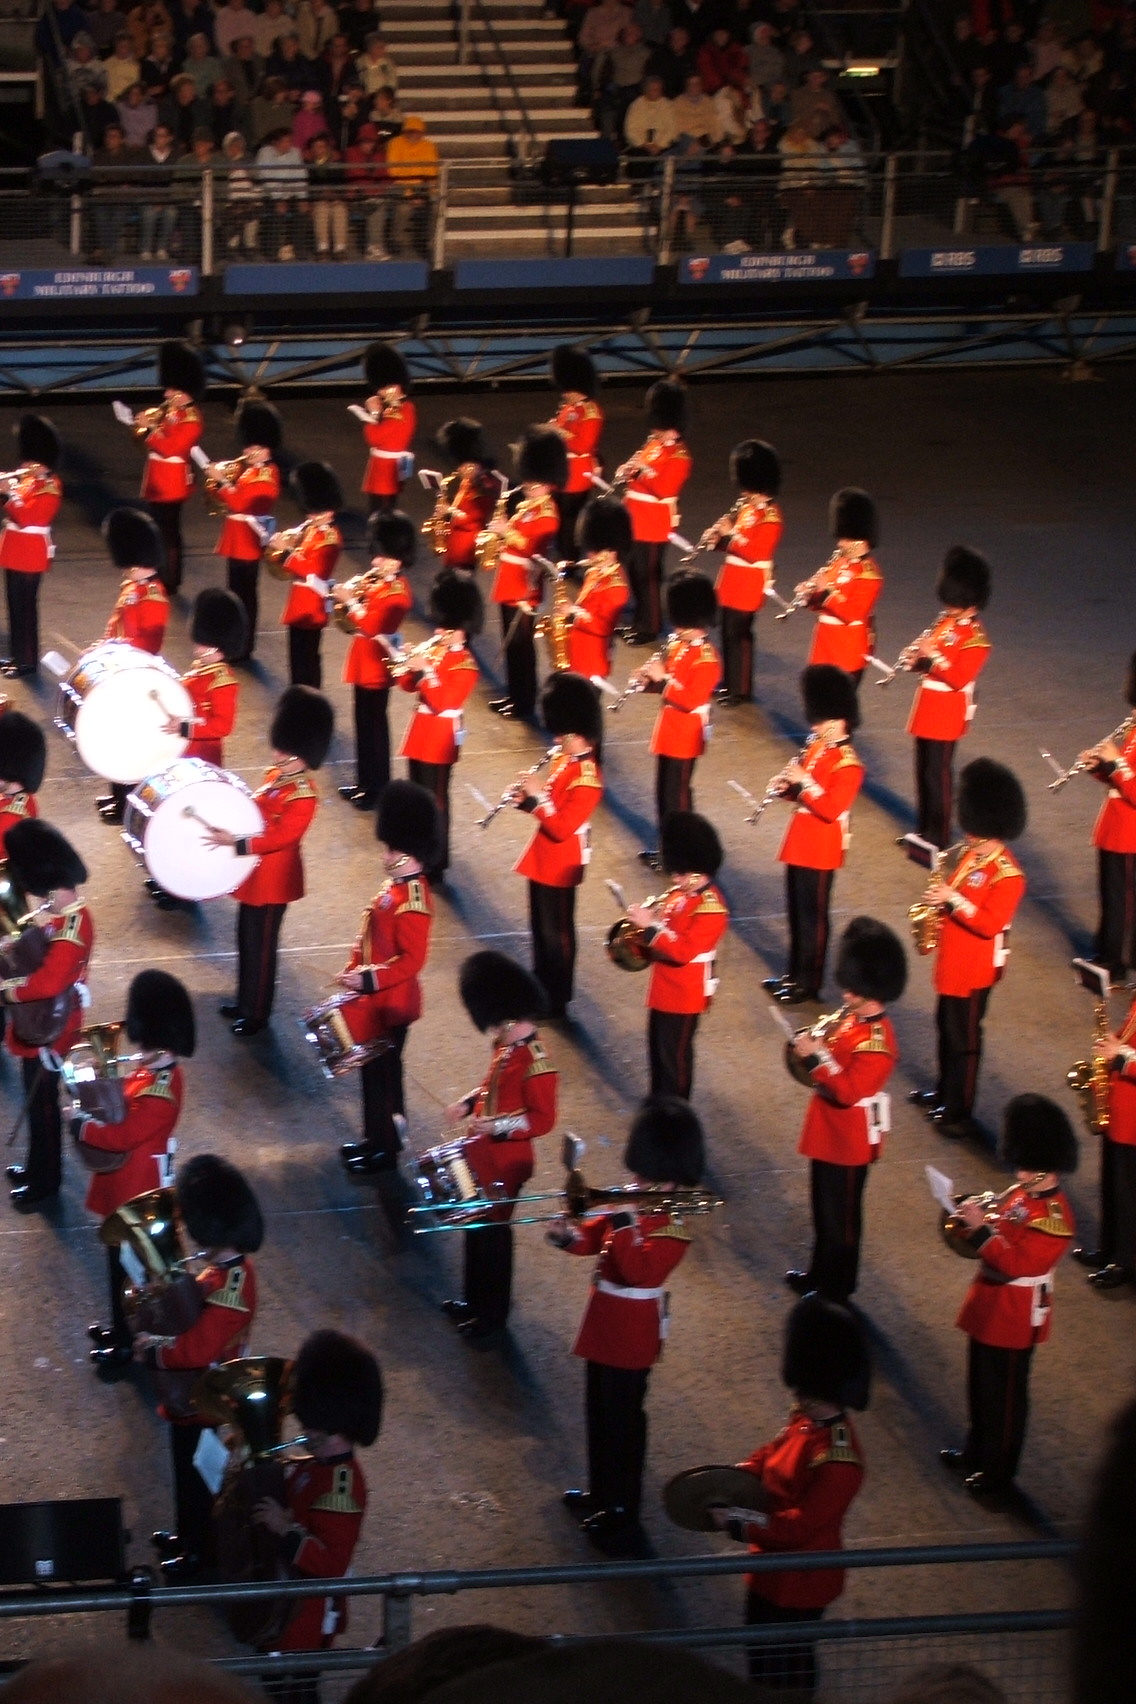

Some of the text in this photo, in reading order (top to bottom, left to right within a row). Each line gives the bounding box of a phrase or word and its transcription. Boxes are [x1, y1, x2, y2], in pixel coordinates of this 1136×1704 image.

[740, 255, 816, 267] EDINBURGH
[948, 251, 977, 267] RBS
[54, 271, 134, 283] EDINBURGH
[721, 266, 834, 280] MILITARY TATTOO
[33, 283, 155, 296] MILITARY TATTOO
